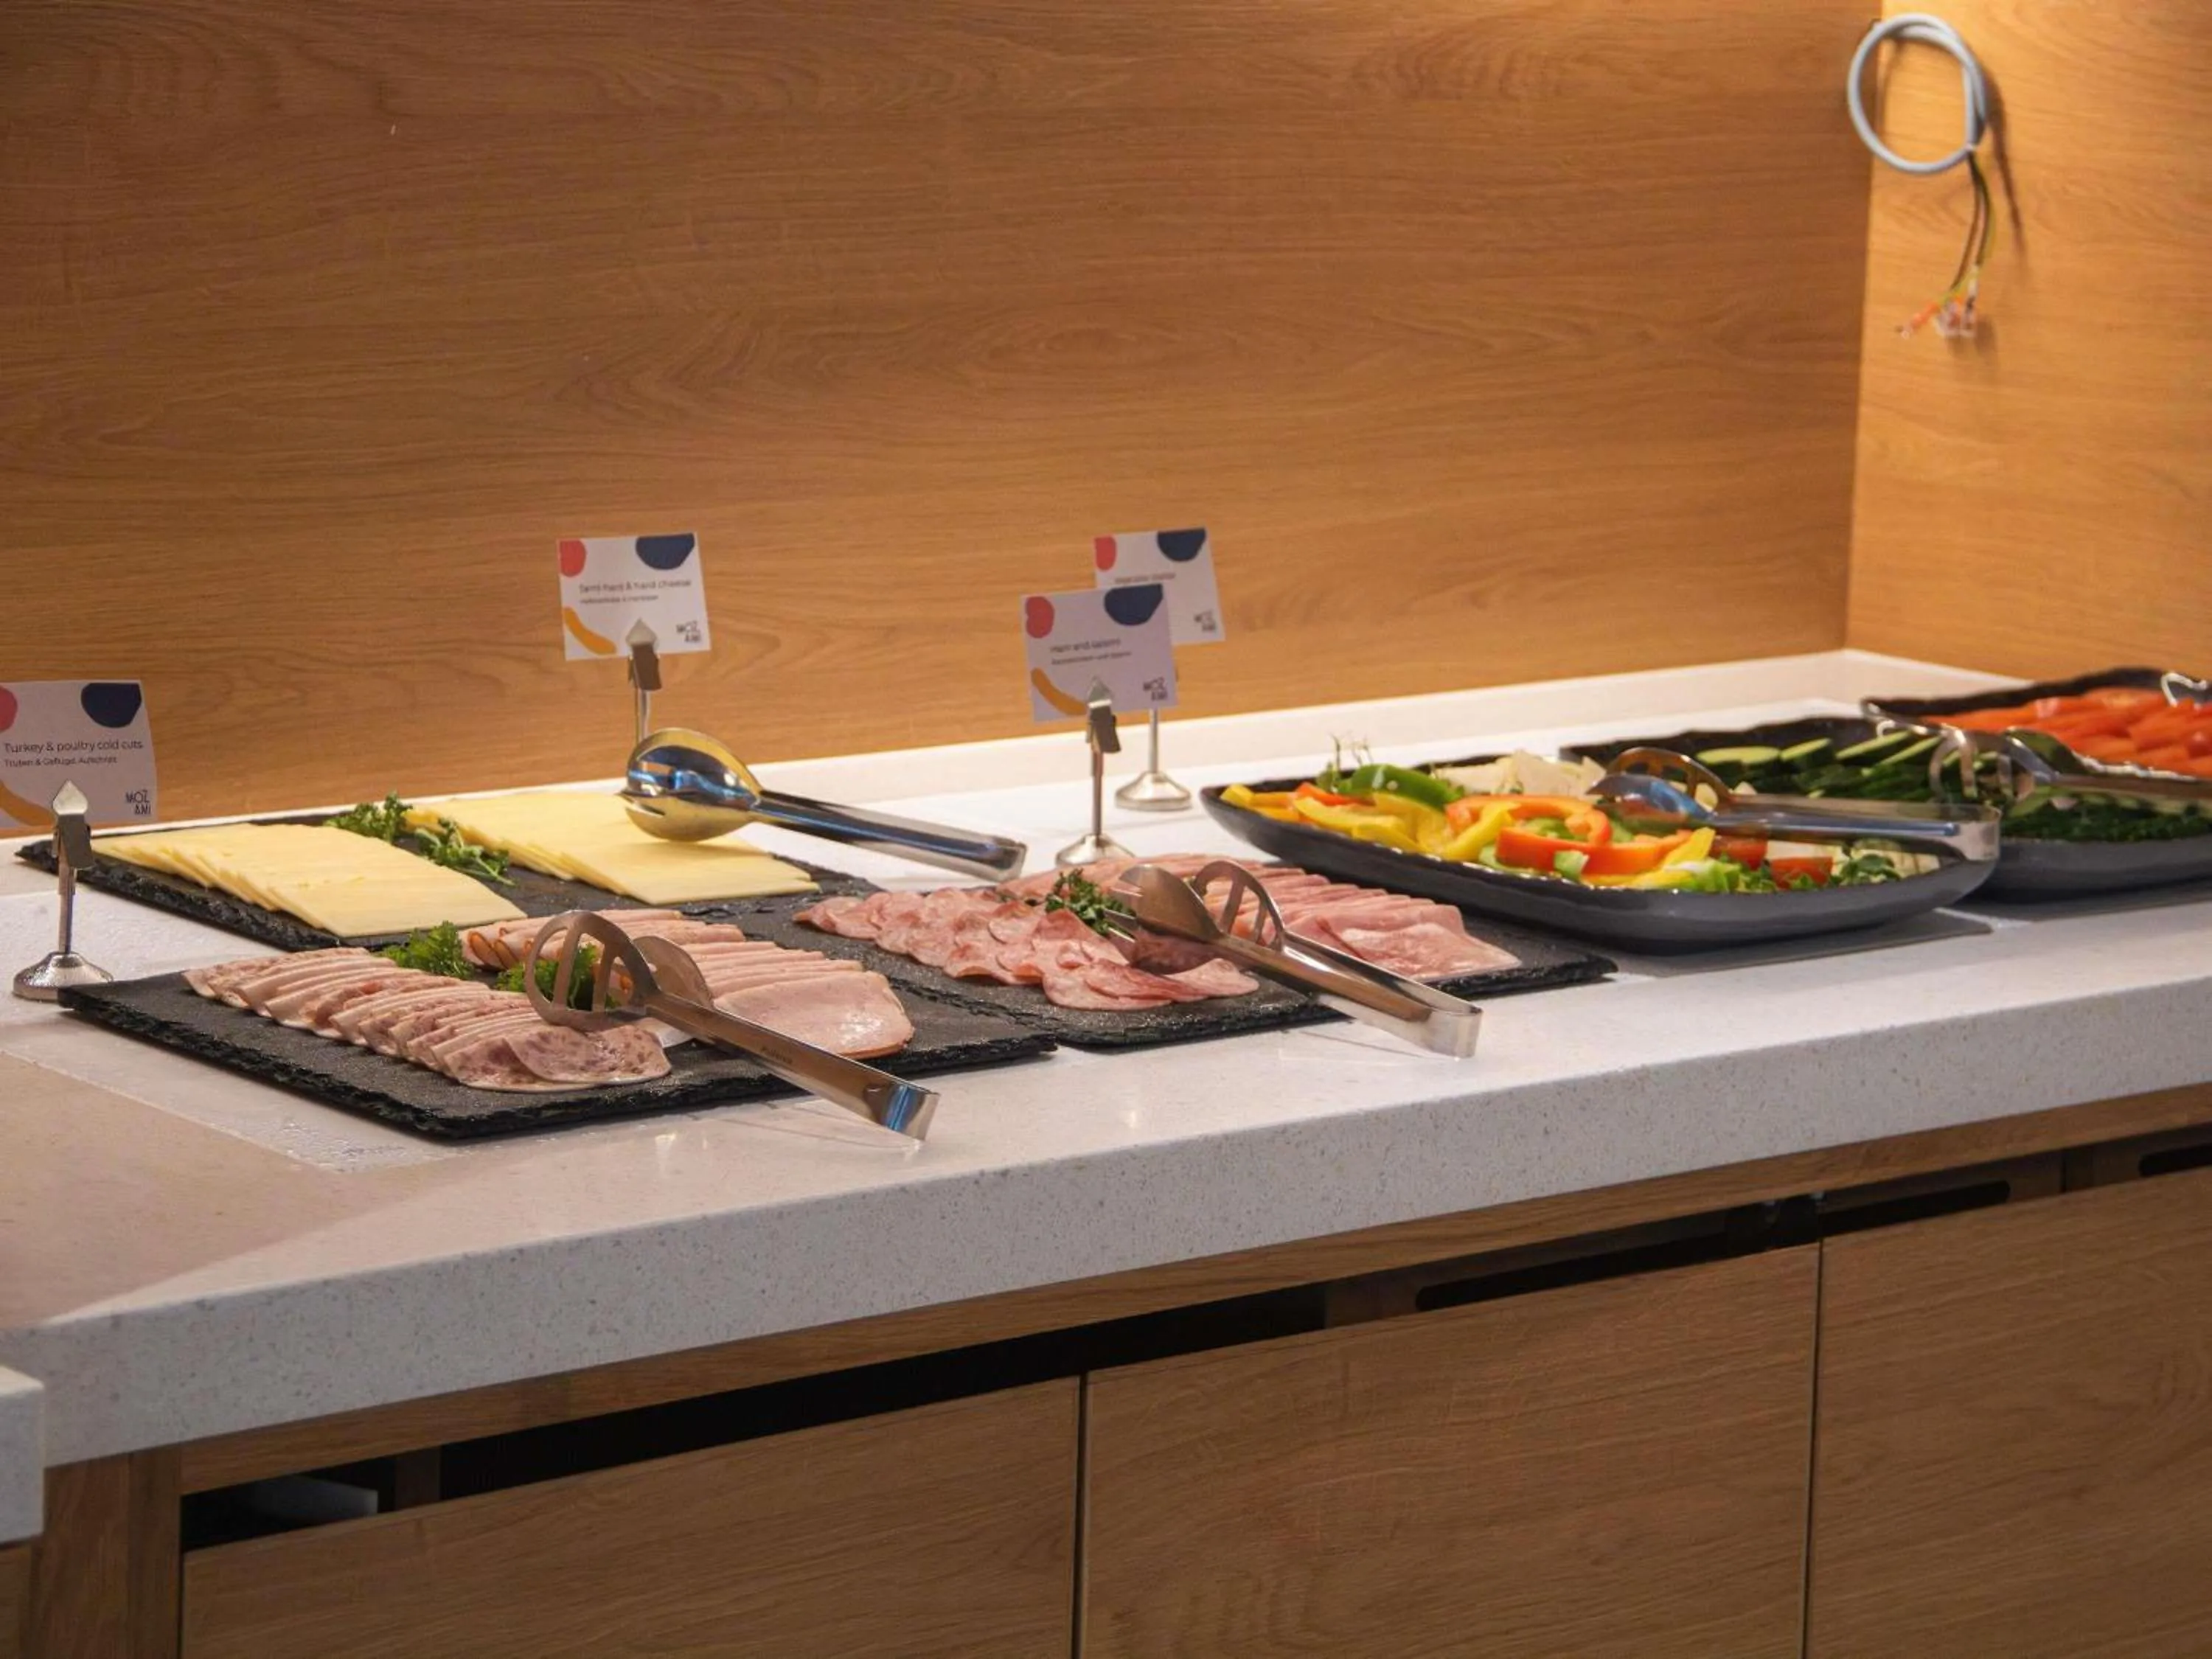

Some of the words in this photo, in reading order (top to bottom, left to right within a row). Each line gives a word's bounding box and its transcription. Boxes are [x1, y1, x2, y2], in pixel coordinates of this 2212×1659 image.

[4, 742, 44, 754] Turkey
[46, 742, 54, 751] &
[57, 740, 95, 752] poultry
[97, 740, 119, 750] cold
[121, 740, 143, 750] cuts
